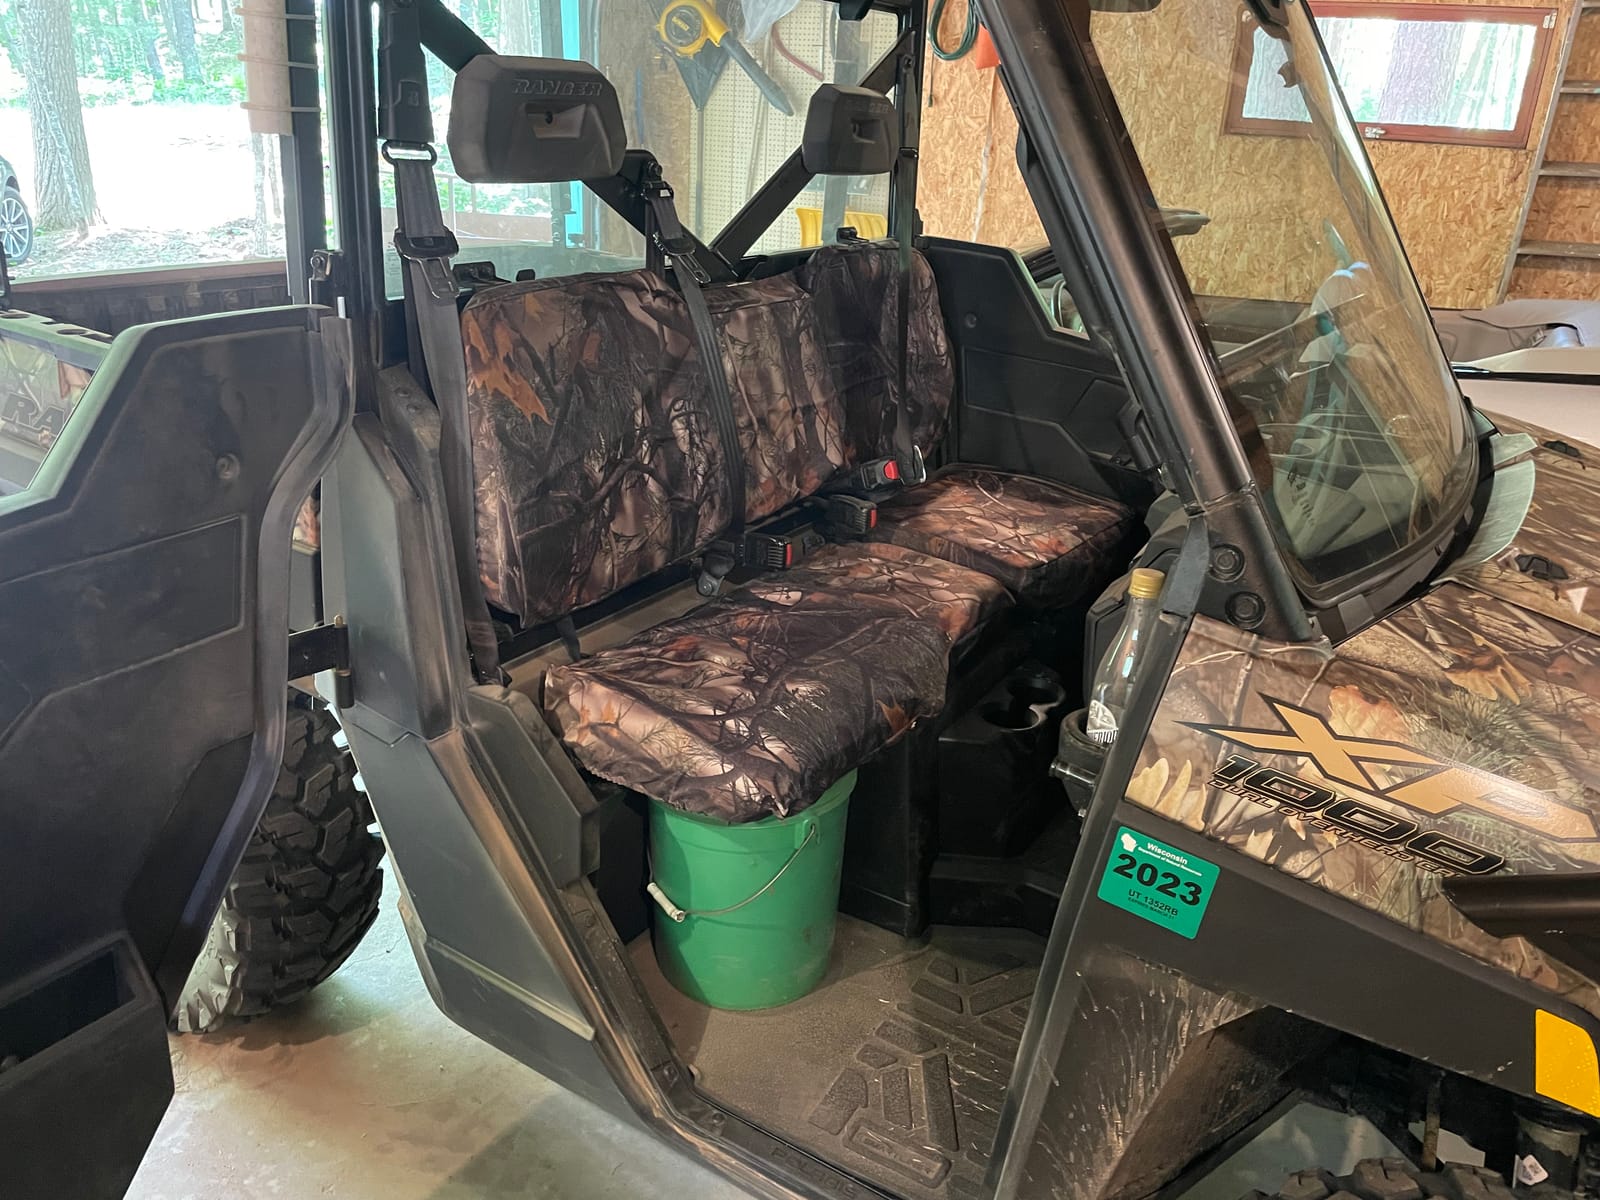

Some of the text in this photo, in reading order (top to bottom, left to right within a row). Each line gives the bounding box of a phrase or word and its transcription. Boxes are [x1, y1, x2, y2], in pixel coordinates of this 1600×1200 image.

[512, 78, 603, 97] RANGER
[1207, 778, 1465, 879] DUAL OVERHEAD CA
[1211, 753, 1507, 876] 1000
[1147, 842, 1188, 865] Wisconsin
[1113, 853, 1202, 906] 2023
[1128, 888, 1179, 917] UT 1352RB
